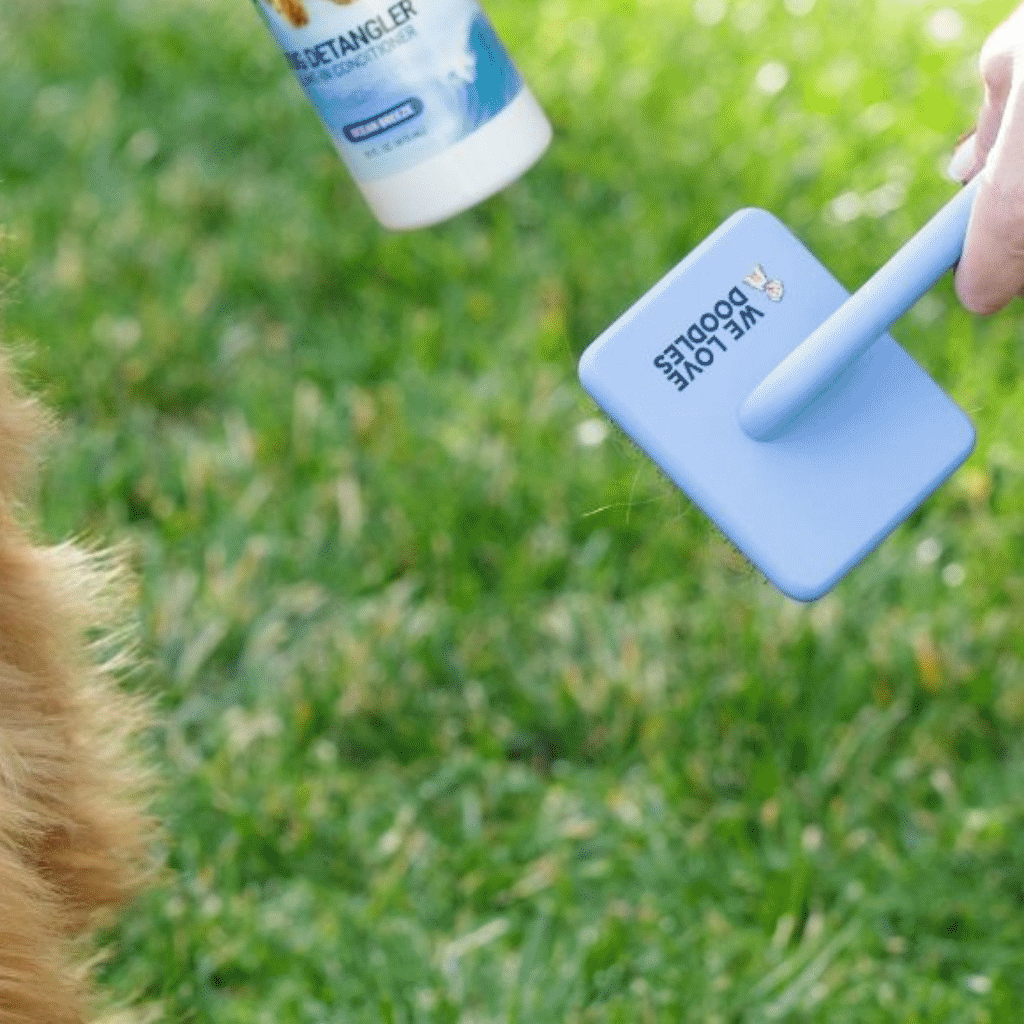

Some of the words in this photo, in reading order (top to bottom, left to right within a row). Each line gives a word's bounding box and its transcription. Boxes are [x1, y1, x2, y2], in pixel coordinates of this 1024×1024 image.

[653, 285, 749, 375] DOODLES
[722, 304, 765, 341] WE
[666, 334, 728, 392] LOVE
